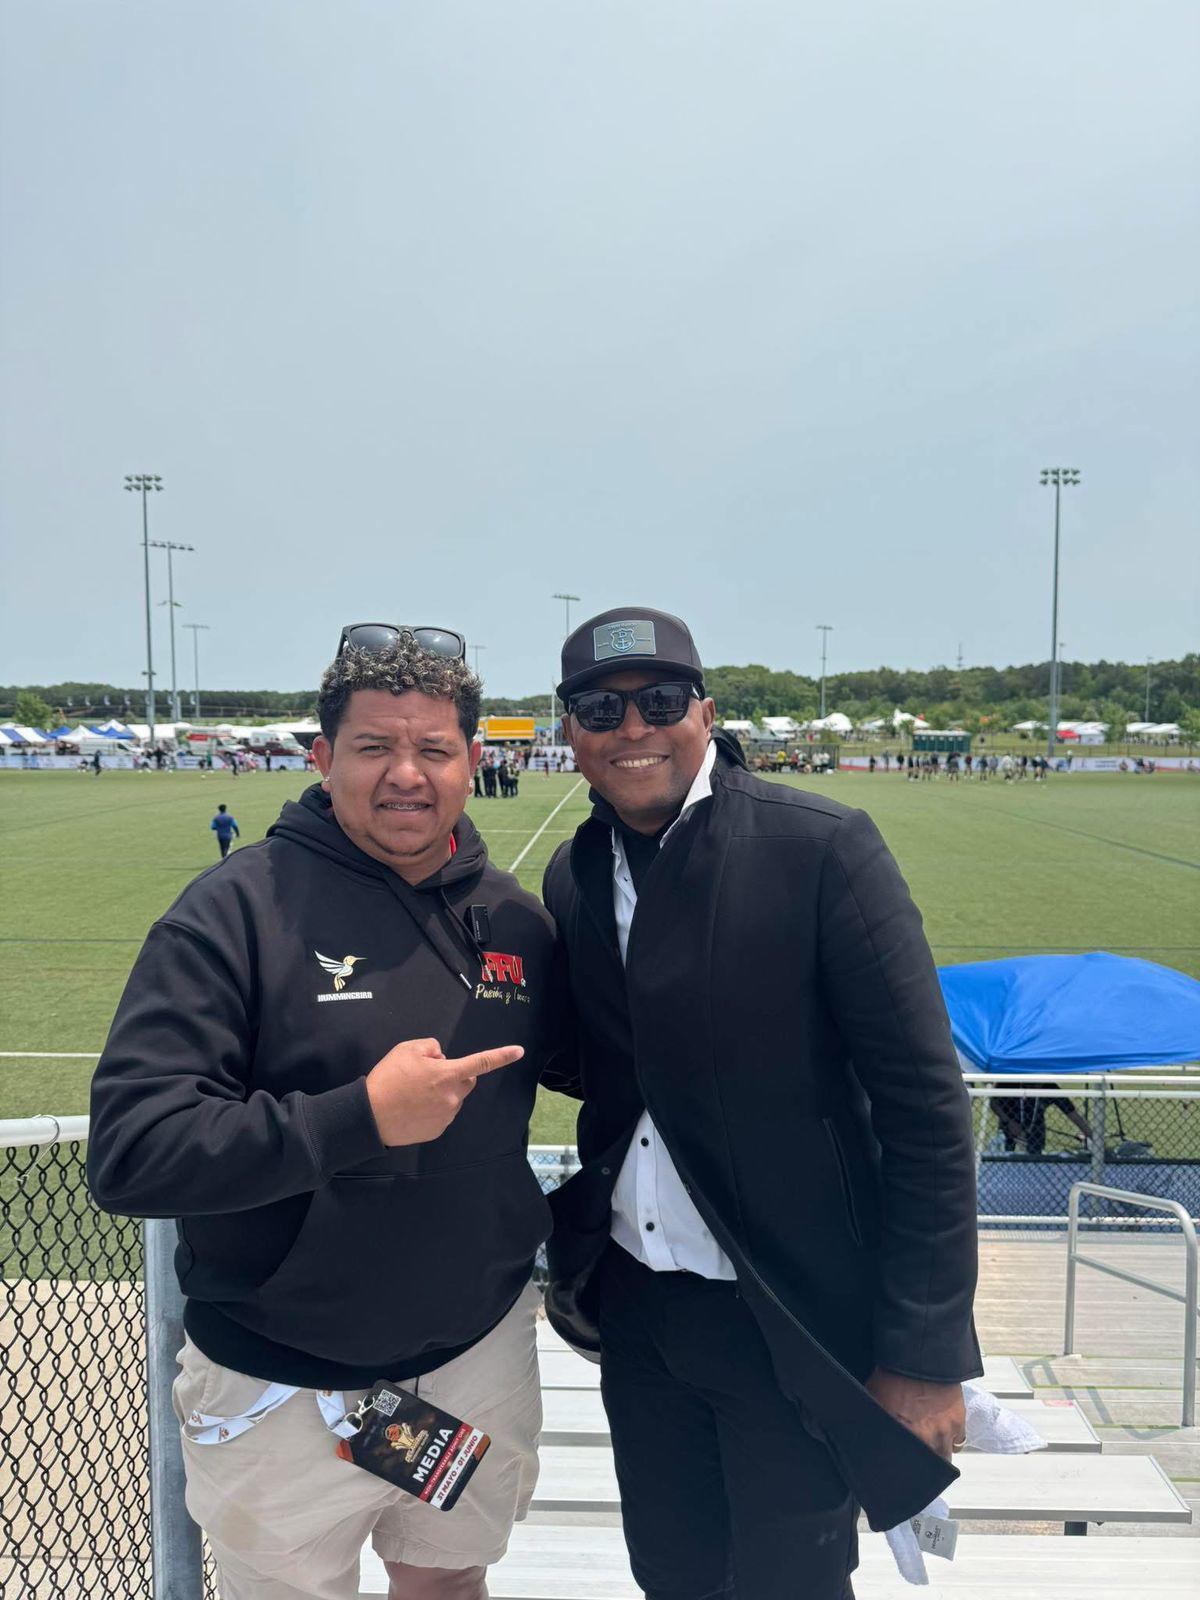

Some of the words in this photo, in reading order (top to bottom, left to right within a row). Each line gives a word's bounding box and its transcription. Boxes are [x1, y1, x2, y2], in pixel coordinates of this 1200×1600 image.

[412, 1429, 453, 1483] MEDIA
[437, 1492, 444, 1500] 31
[442, 1470, 457, 1493] MAYO
[457, 1457, 465, 1466] 01
[463, 1435, 478, 1457] JUNIO
